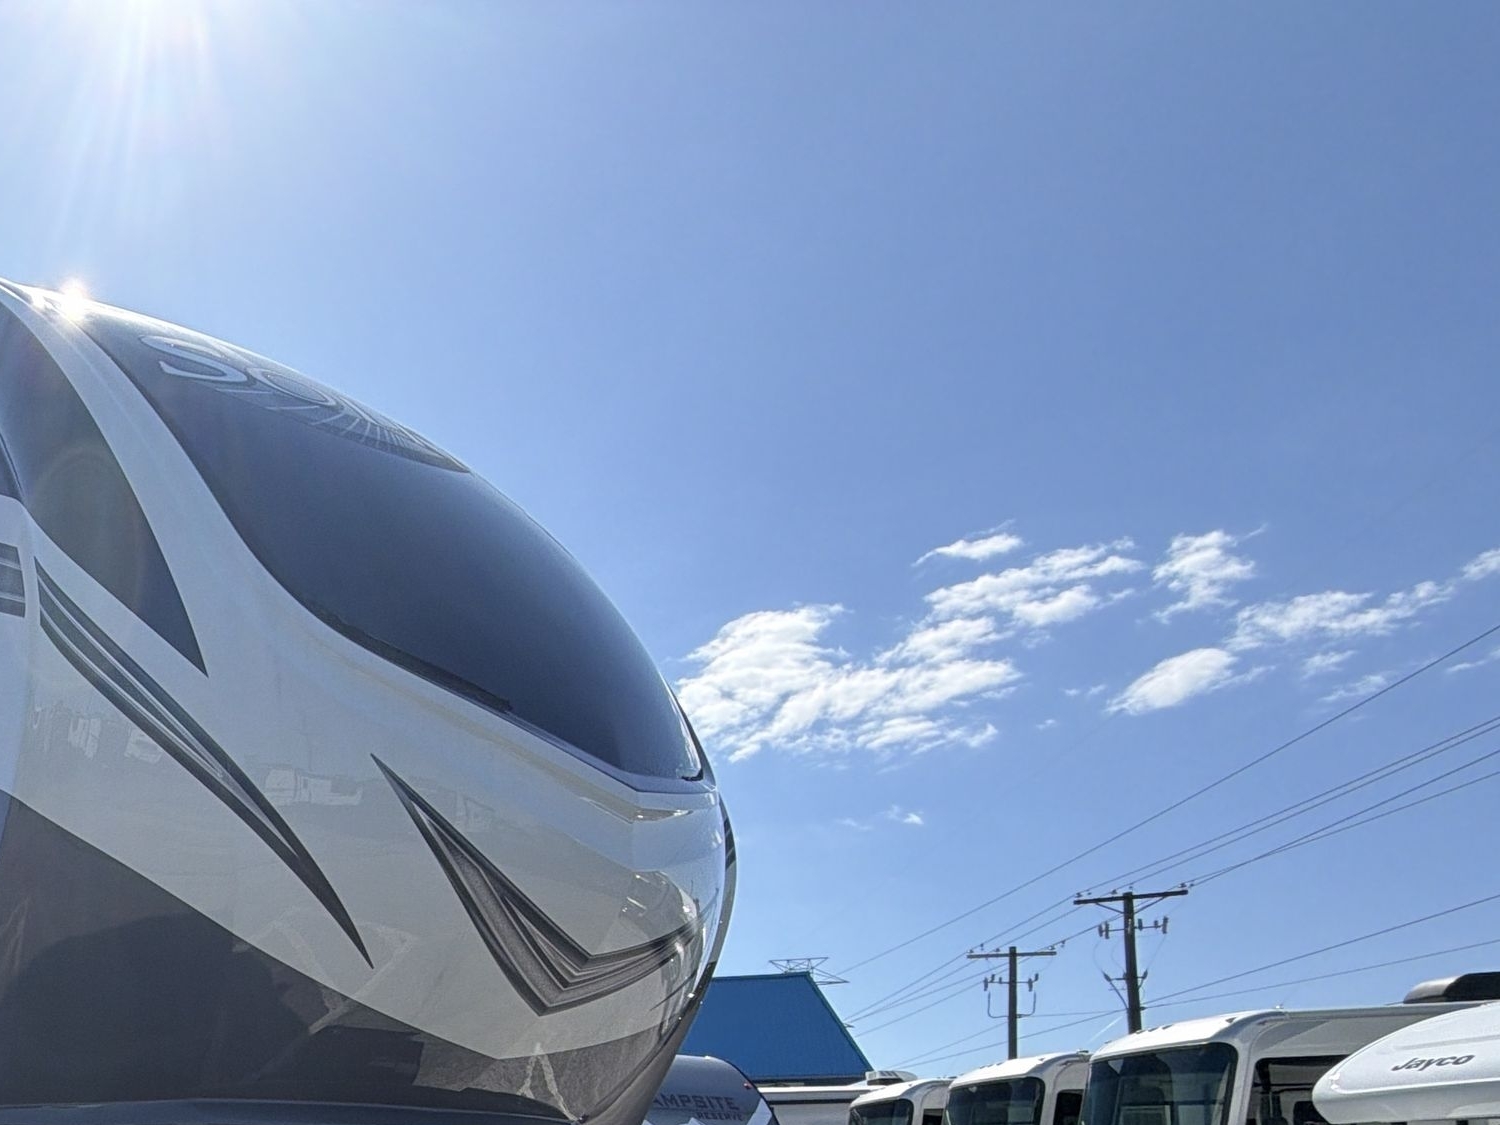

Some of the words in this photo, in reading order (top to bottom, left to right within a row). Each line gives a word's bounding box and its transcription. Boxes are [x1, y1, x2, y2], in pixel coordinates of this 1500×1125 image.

[1391, 1055, 1475, 1071] Jayco
[652, 1092, 740, 1111] AMPSITE
[695, 1111, 744, 1122] RESERVE
